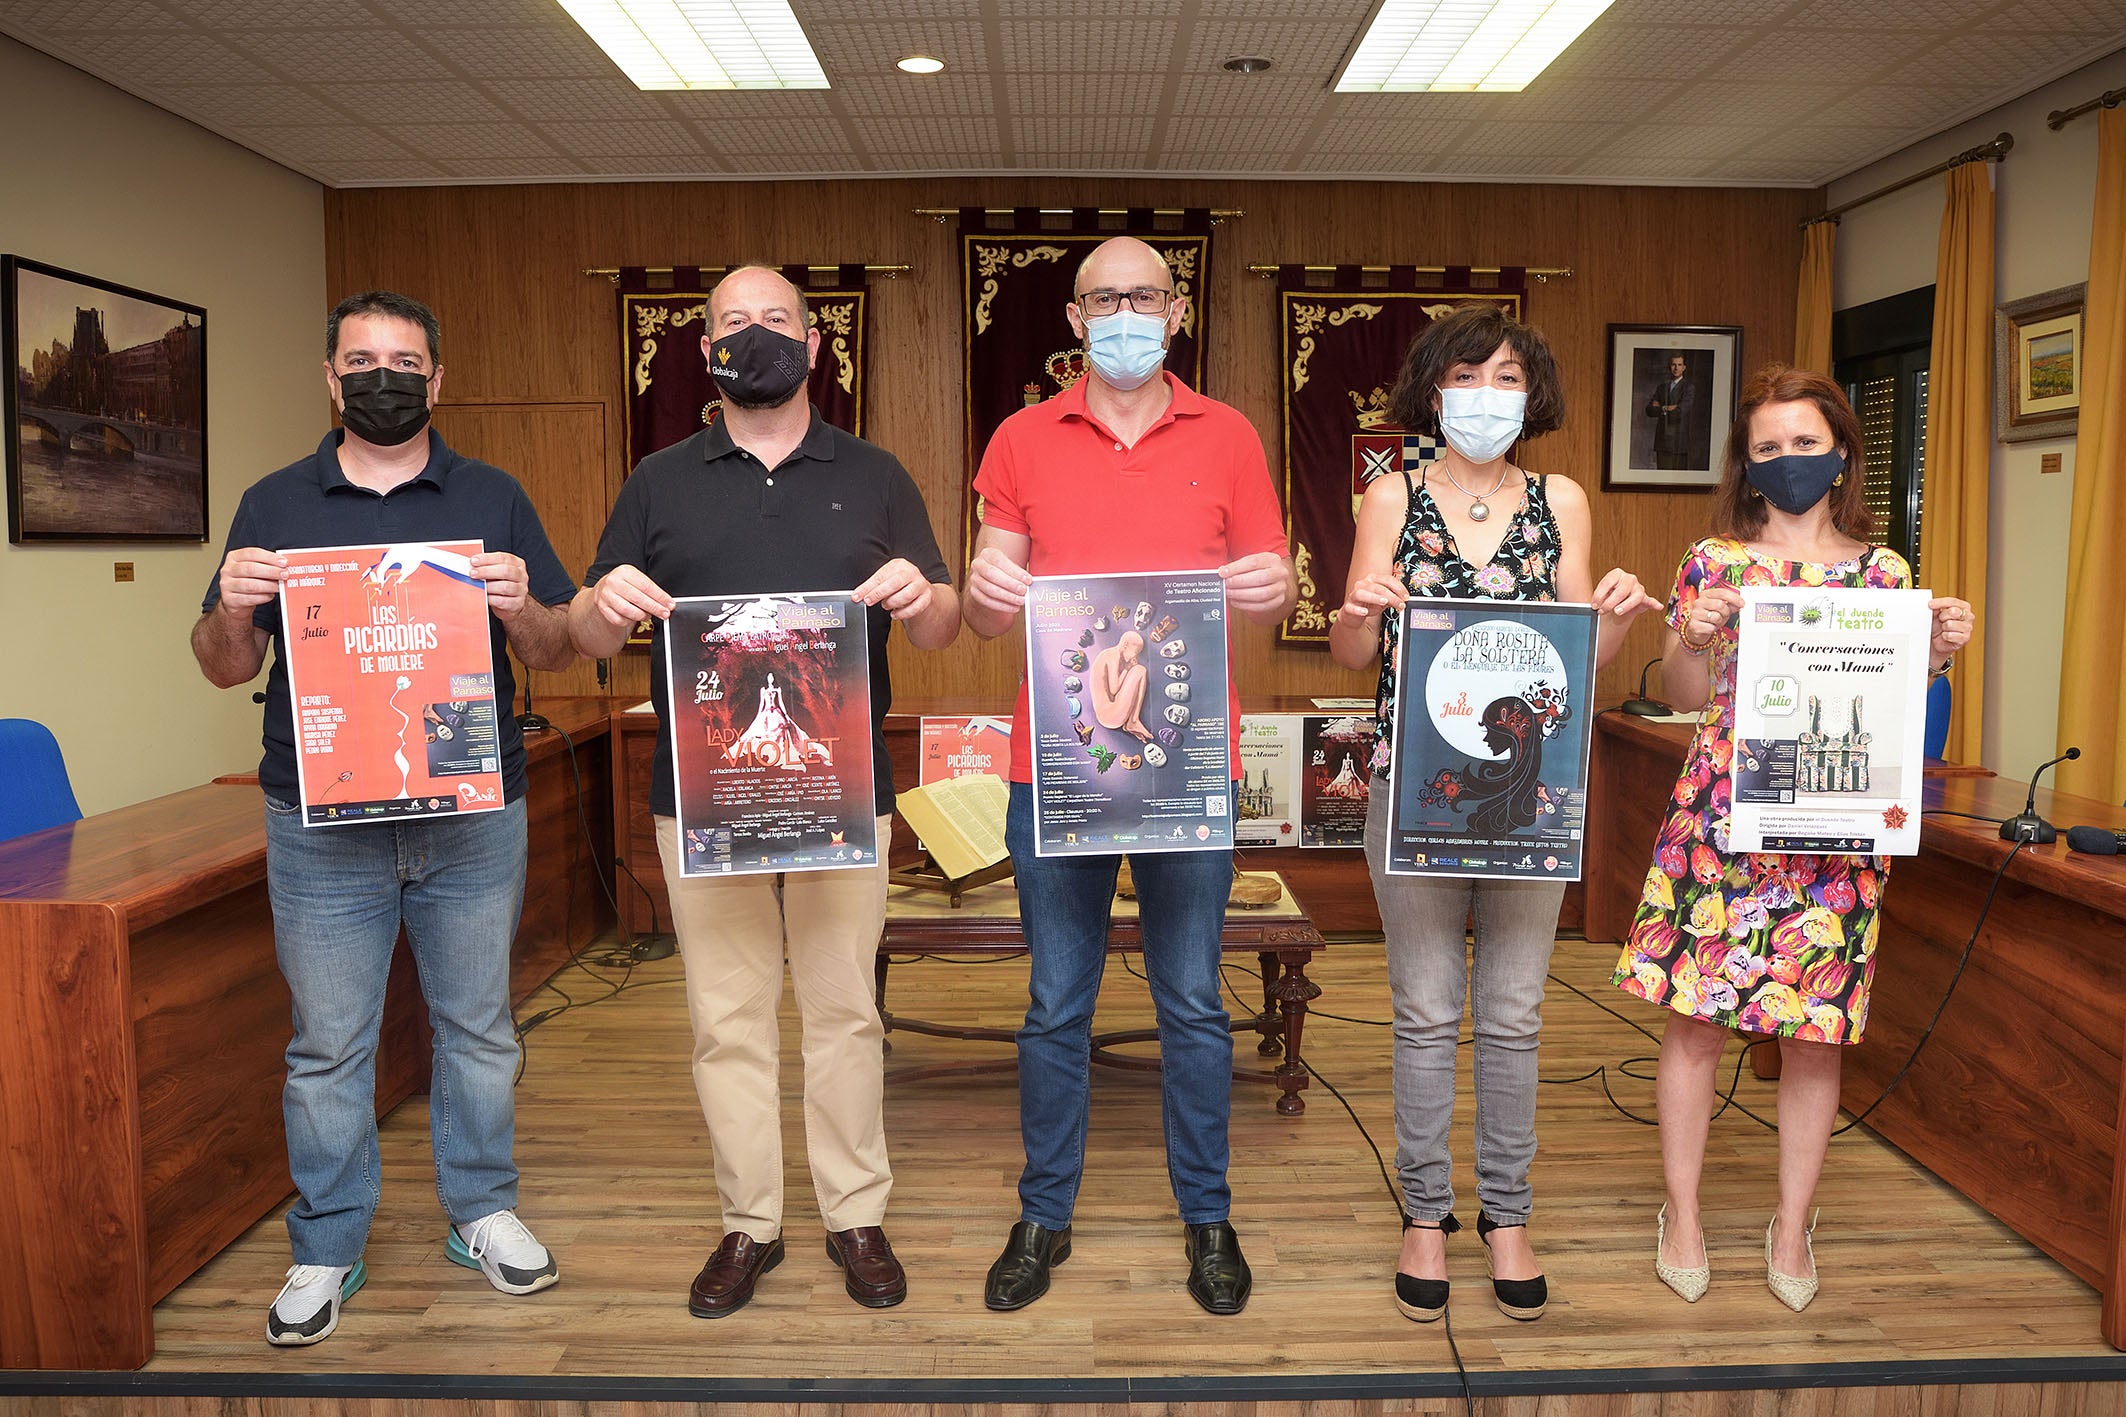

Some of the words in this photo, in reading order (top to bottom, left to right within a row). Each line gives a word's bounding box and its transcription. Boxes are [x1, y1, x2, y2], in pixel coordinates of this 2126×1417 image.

[1034, 589, 1070, 604] Viaje
[1074, 587, 1088, 600] al
[306, 604, 321, 620] 17
[372, 605, 397, 625] LAS
[781, 604, 816, 617] Viaje
[820, 604, 834, 616] al
[1035, 605, 1095, 618] Parnaso
[1757, 603, 1778, 614] Viaje
[1779, 605, 1788, 613] al
[1837, 608, 1846, 617] el
[1850, 608, 1884, 617] duende
[1413, 611, 1437, 621] Viaje
[1439, 612, 1448, 620] al
[782, 617, 840, 629] Parnaso
[1837, 618, 1884, 630] teatro
[301, 627, 328, 640] Julio
[344, 616, 438, 654] PICARDÍAS
[1454, 630, 1489, 647] DOÑA
[1497, 632, 1548, 648] ROSITA
[360, 656, 375, 673] DE
[378, 651, 424, 672] MOLIÈRE
[1453, 647, 1473, 664] LA
[1480, 648, 1546, 665] SOLTERA
[1808, 663, 1831, 672] con
[451, 677, 477, 686] Viaje
[480, 675, 489, 684] al
[696, 670, 720, 690] 24
[1771, 679, 1784, 691] 10
[453, 686, 493, 696] Parnaso
[694, 688, 723, 704] Julio
[1458, 692, 1467, 704] 3
[1761, 694, 1792, 709] Julio
[1440, 701, 1474, 718] Julio
[706, 725, 744, 747] LADY
[720, 737, 840, 767] VIOLET
[962, 745, 973, 754] LAS
[1313, 750, 1325, 760] 24
[947, 751, 992, 768] PICARDÍAS
[1322, 784, 1369, 796] VIOLE
